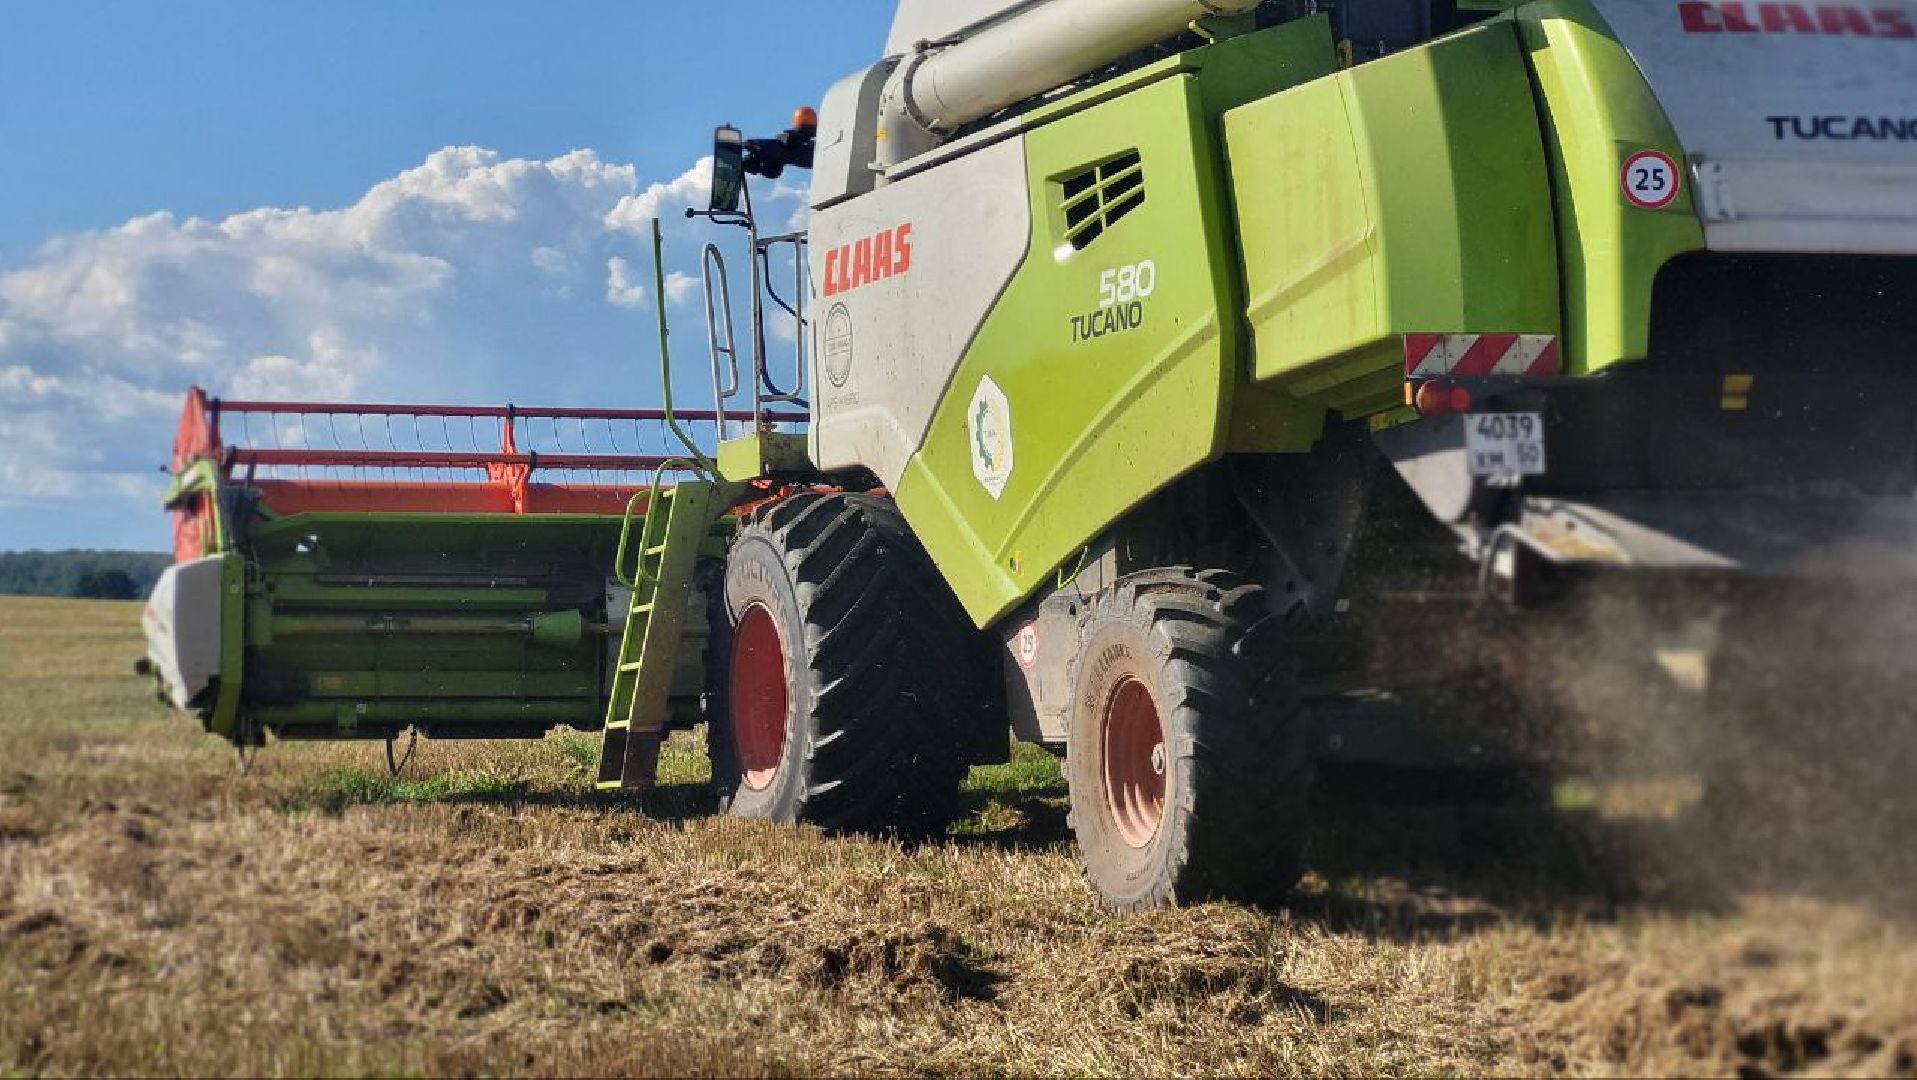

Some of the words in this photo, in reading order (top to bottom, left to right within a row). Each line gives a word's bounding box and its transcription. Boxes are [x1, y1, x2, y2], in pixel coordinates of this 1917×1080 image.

[1677, 2, 1917, 39] CLAAS
[1634, 168, 1666, 192] 25
[823, 222, 913, 298] CLAAS
[1099, 258, 1156, 308] 580
[1070, 300, 1143, 343] TUCANO
